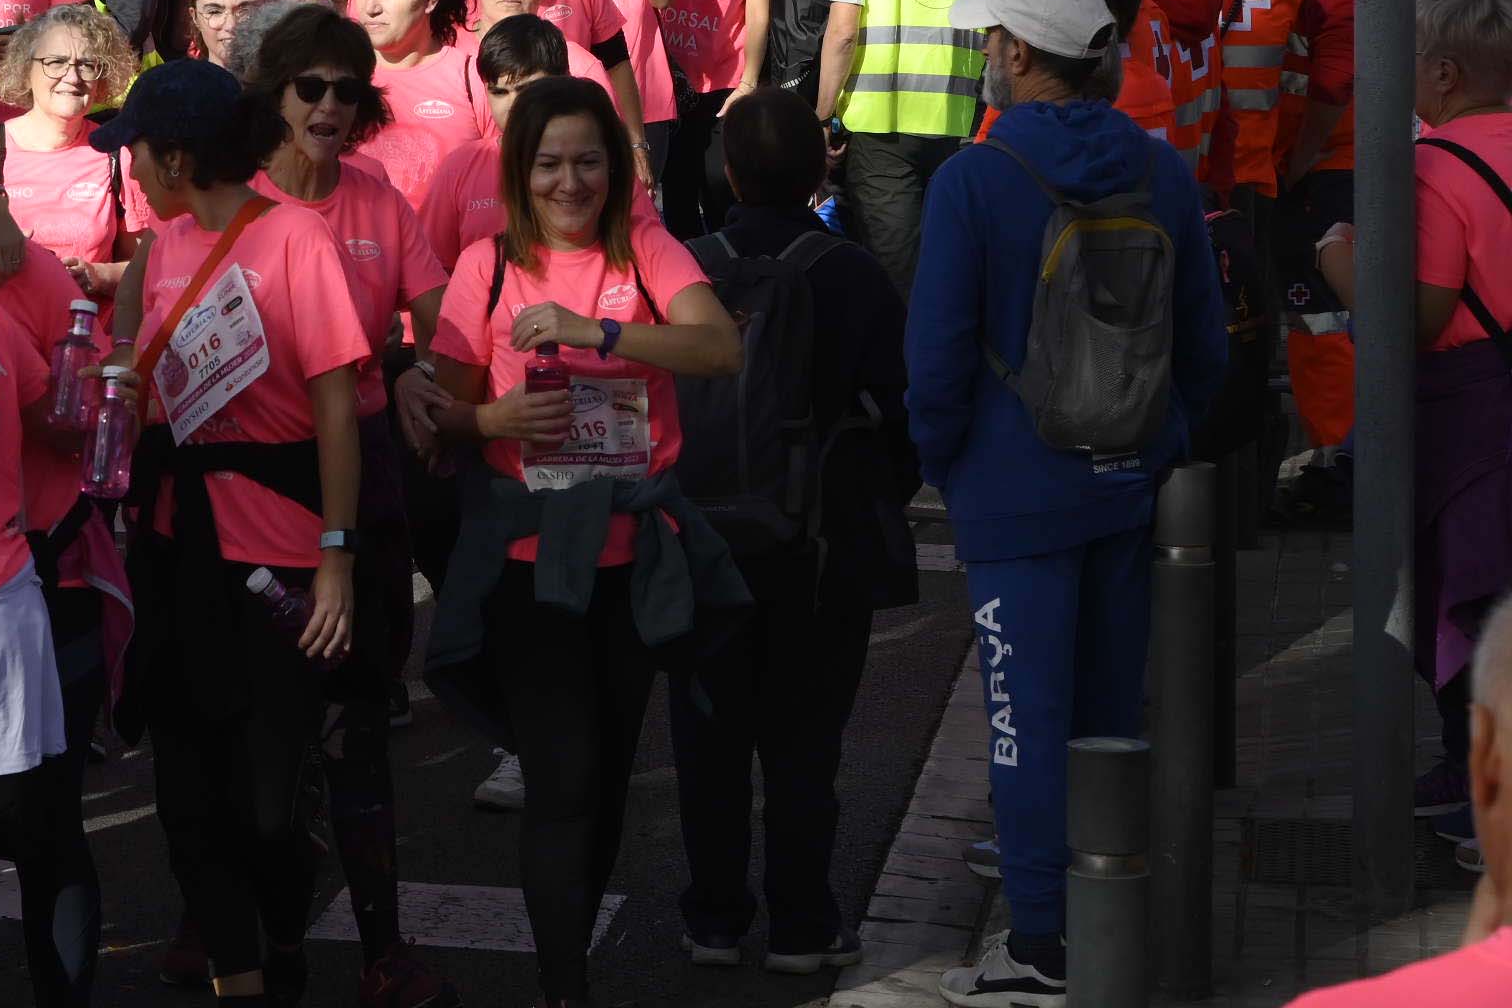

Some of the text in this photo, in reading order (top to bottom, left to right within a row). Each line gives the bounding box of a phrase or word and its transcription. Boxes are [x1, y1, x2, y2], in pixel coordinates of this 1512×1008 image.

[188, 333, 222, 370] 016
[198, 356, 222, 380] 7705
[568, 420, 607, 441] 016
[1093, 462, 1119, 474] SINCE
[974, 597, 1018, 767] BARÇA
